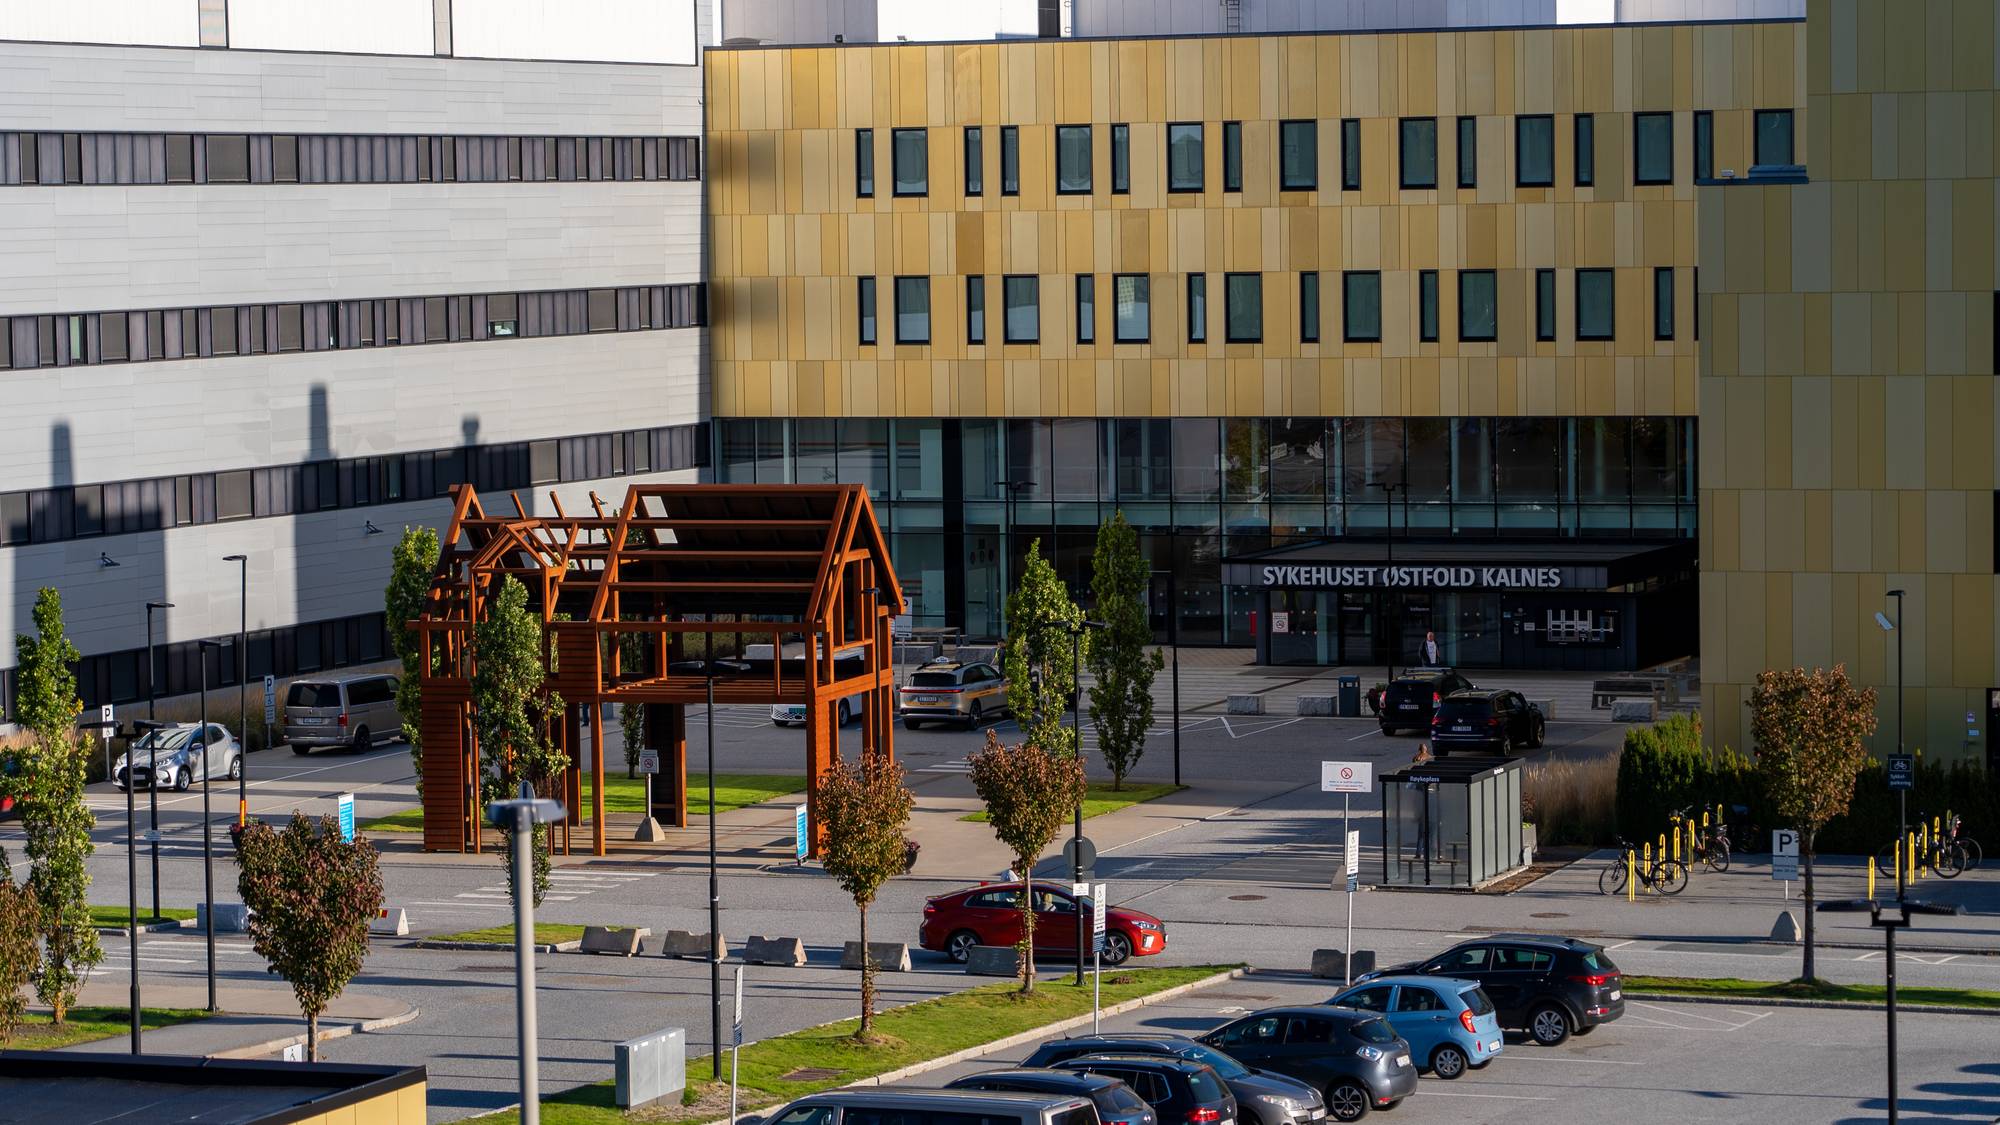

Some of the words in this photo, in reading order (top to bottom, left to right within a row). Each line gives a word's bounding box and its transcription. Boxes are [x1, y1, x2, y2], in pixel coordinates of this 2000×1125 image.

[1263, 567, 1377, 586] SYKEHUSET
[1383, 566, 1475, 588] ØSTFOLD
[1482, 567, 1560, 587] KALNES
[267, 678, 273, 692] P
[105, 708, 111, 721] P
[1779, 833, 1793, 852] P
